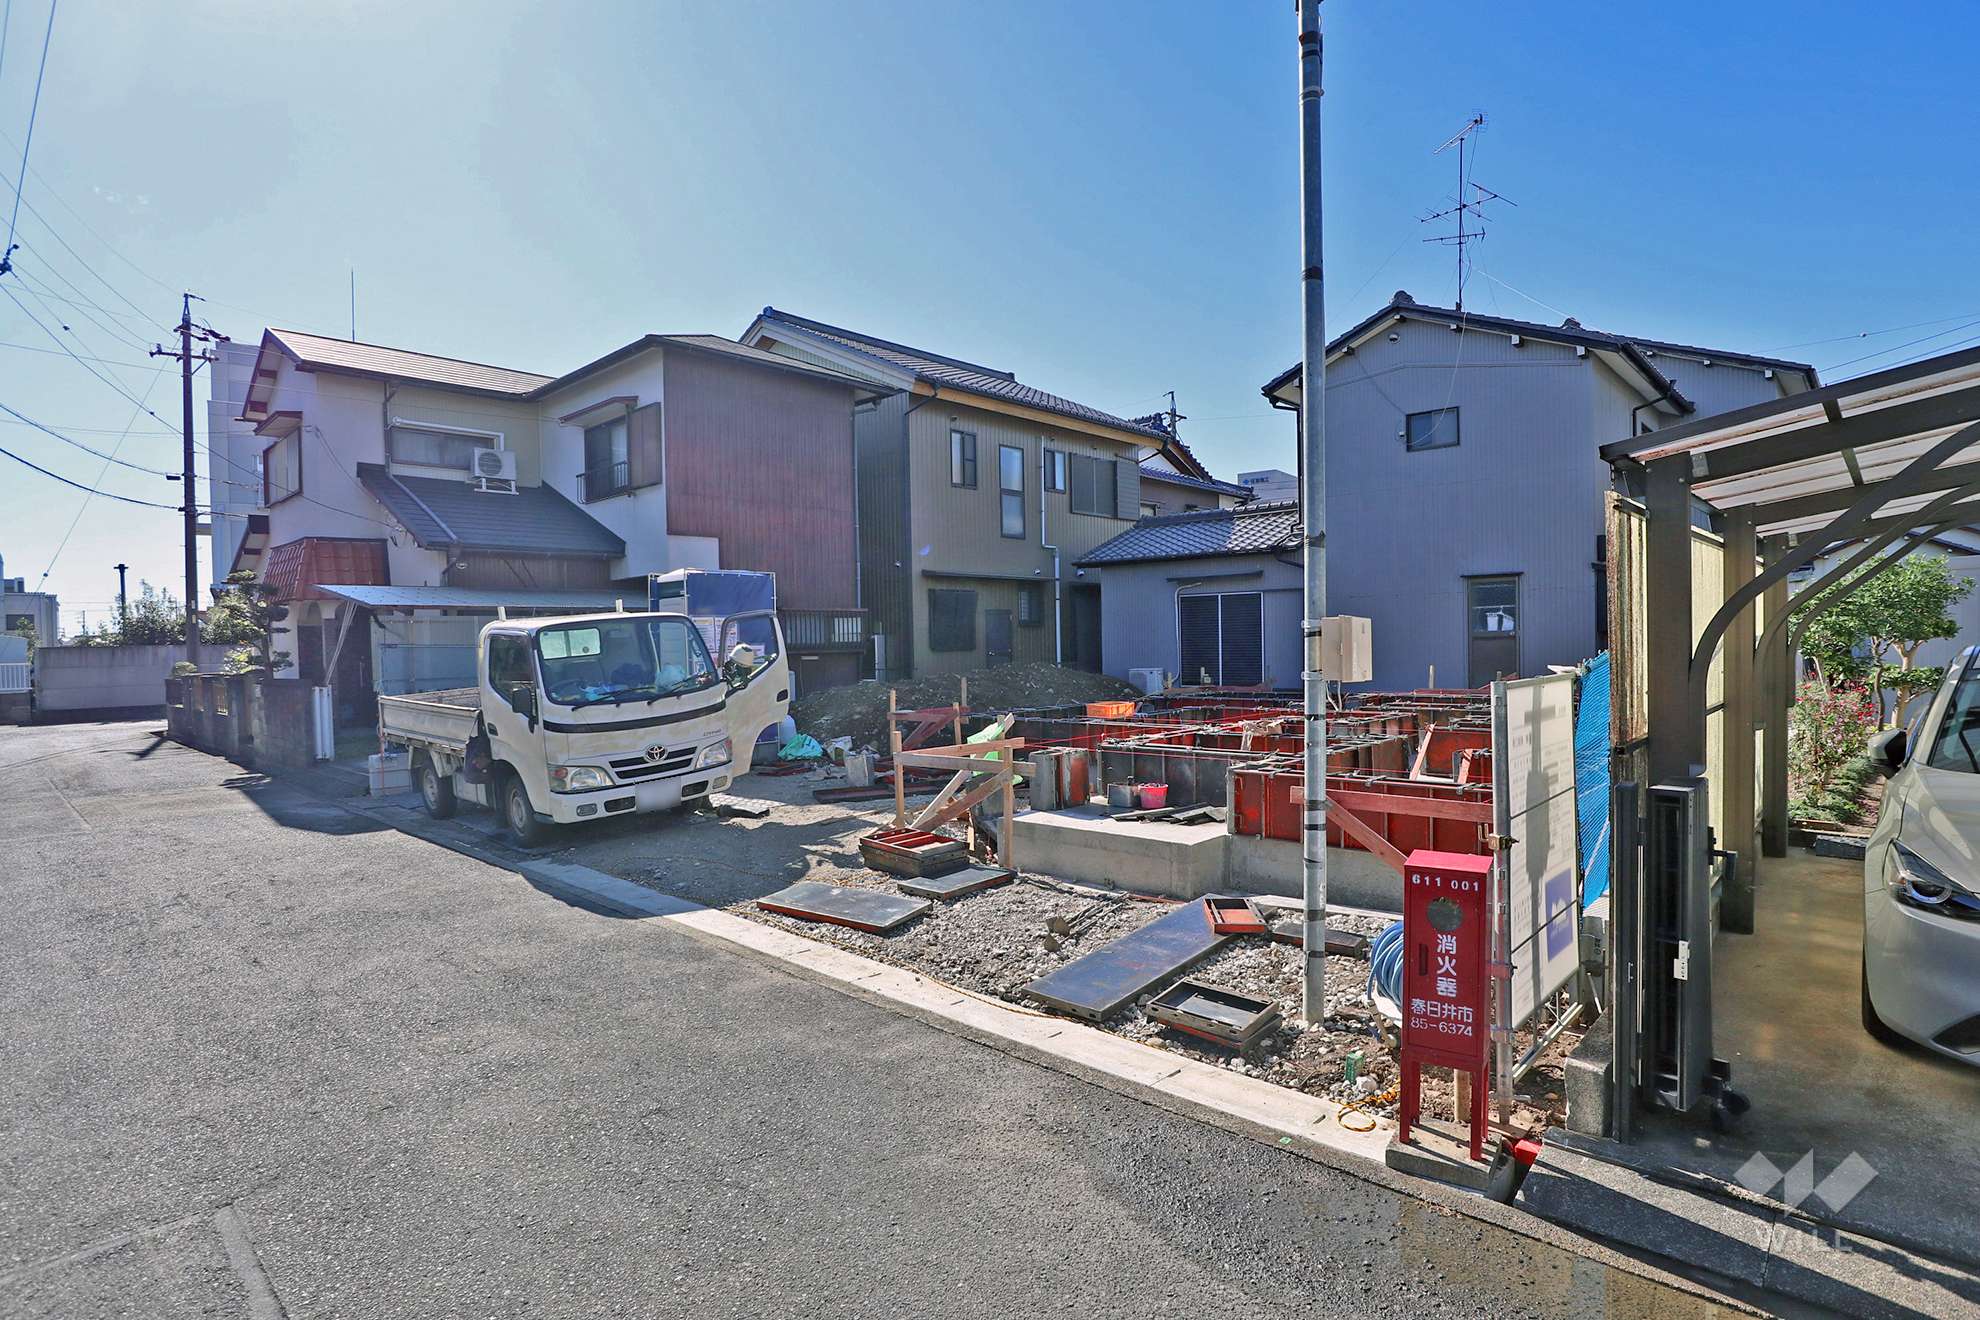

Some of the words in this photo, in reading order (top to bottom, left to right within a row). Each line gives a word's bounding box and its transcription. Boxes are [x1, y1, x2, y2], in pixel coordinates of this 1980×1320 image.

[1412, 874, 1441, 887] 611
[1450, 879, 1479, 892] 001
[1436, 933, 1457, 998] 消火器
[1410, 998, 1473, 1023] 春日井市
[1410, 1016, 1473, 1037] 85-6374
